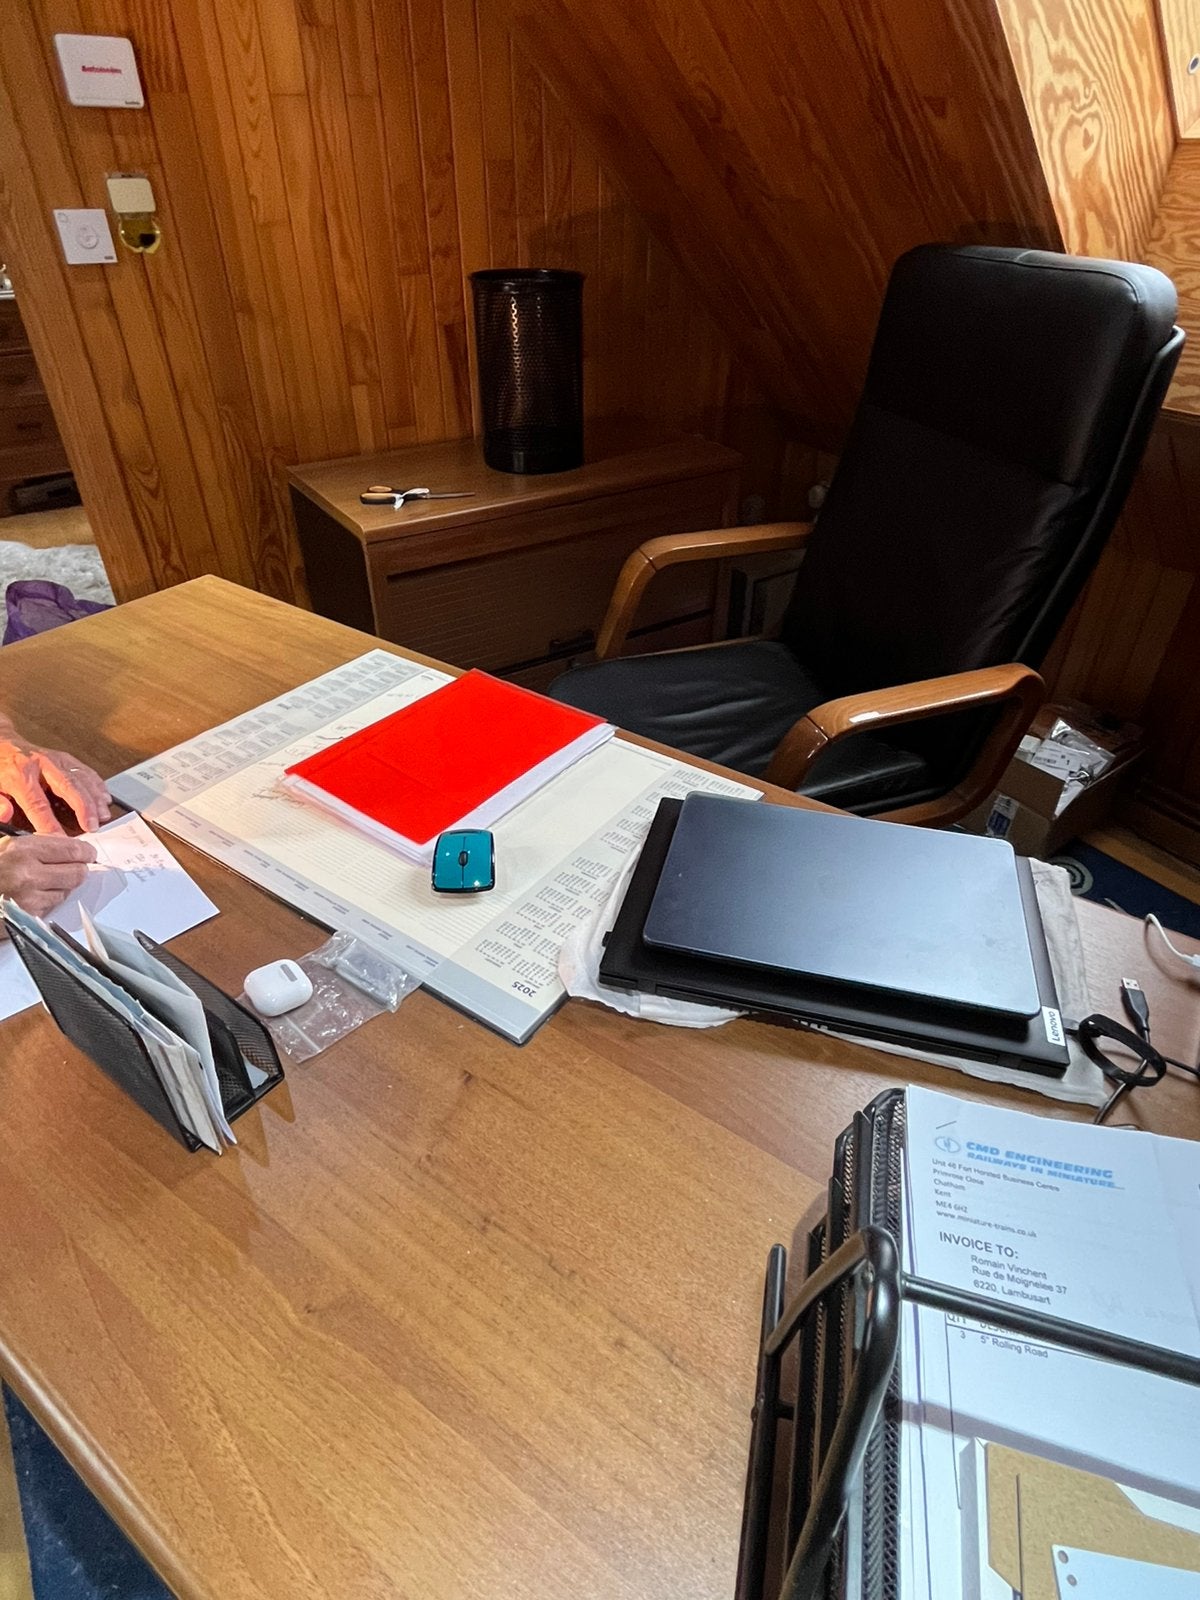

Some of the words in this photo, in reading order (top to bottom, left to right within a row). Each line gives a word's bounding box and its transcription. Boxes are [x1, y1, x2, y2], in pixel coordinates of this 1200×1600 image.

[511, 981, 536, 998] 2025
[1048, 1010, 1061, 1042] Lenovo
[966, 1141, 1001, 1156] CMD
[1005, 1150, 1113, 1179] ENGINEERING
[967, 1152, 1027, 1171] RAILWAYS
[1031, 1166, 1044, 1175] IN
[932, 1158, 946, 1167] Unit
[1003, 1174, 1035, 1187] Business
[1036, 1181, 1060, 1192] Centre
[933, 1168, 964, 1181] Primrose
[934, 1188, 952, 1198] Kent
[939, 1231, 993, 1253] INVOICE
[995, 1244, 1019, 1259] TO:
[971, 1255, 1006, 1270] Romain
[1007, 1263, 1048, 1280] Vinchent
[972, 1265, 991, 1278] Rue
[993, 1271, 1005, 1280] de
[1055, 1285, 1067, 1295] 37
[1001, 1285, 1051, 1305] Lambusart
[960, 1330, 966, 1339] 3
[991, 1337, 1022, 1354] Rolling
[1024, 1345, 1048, 1358] Road
